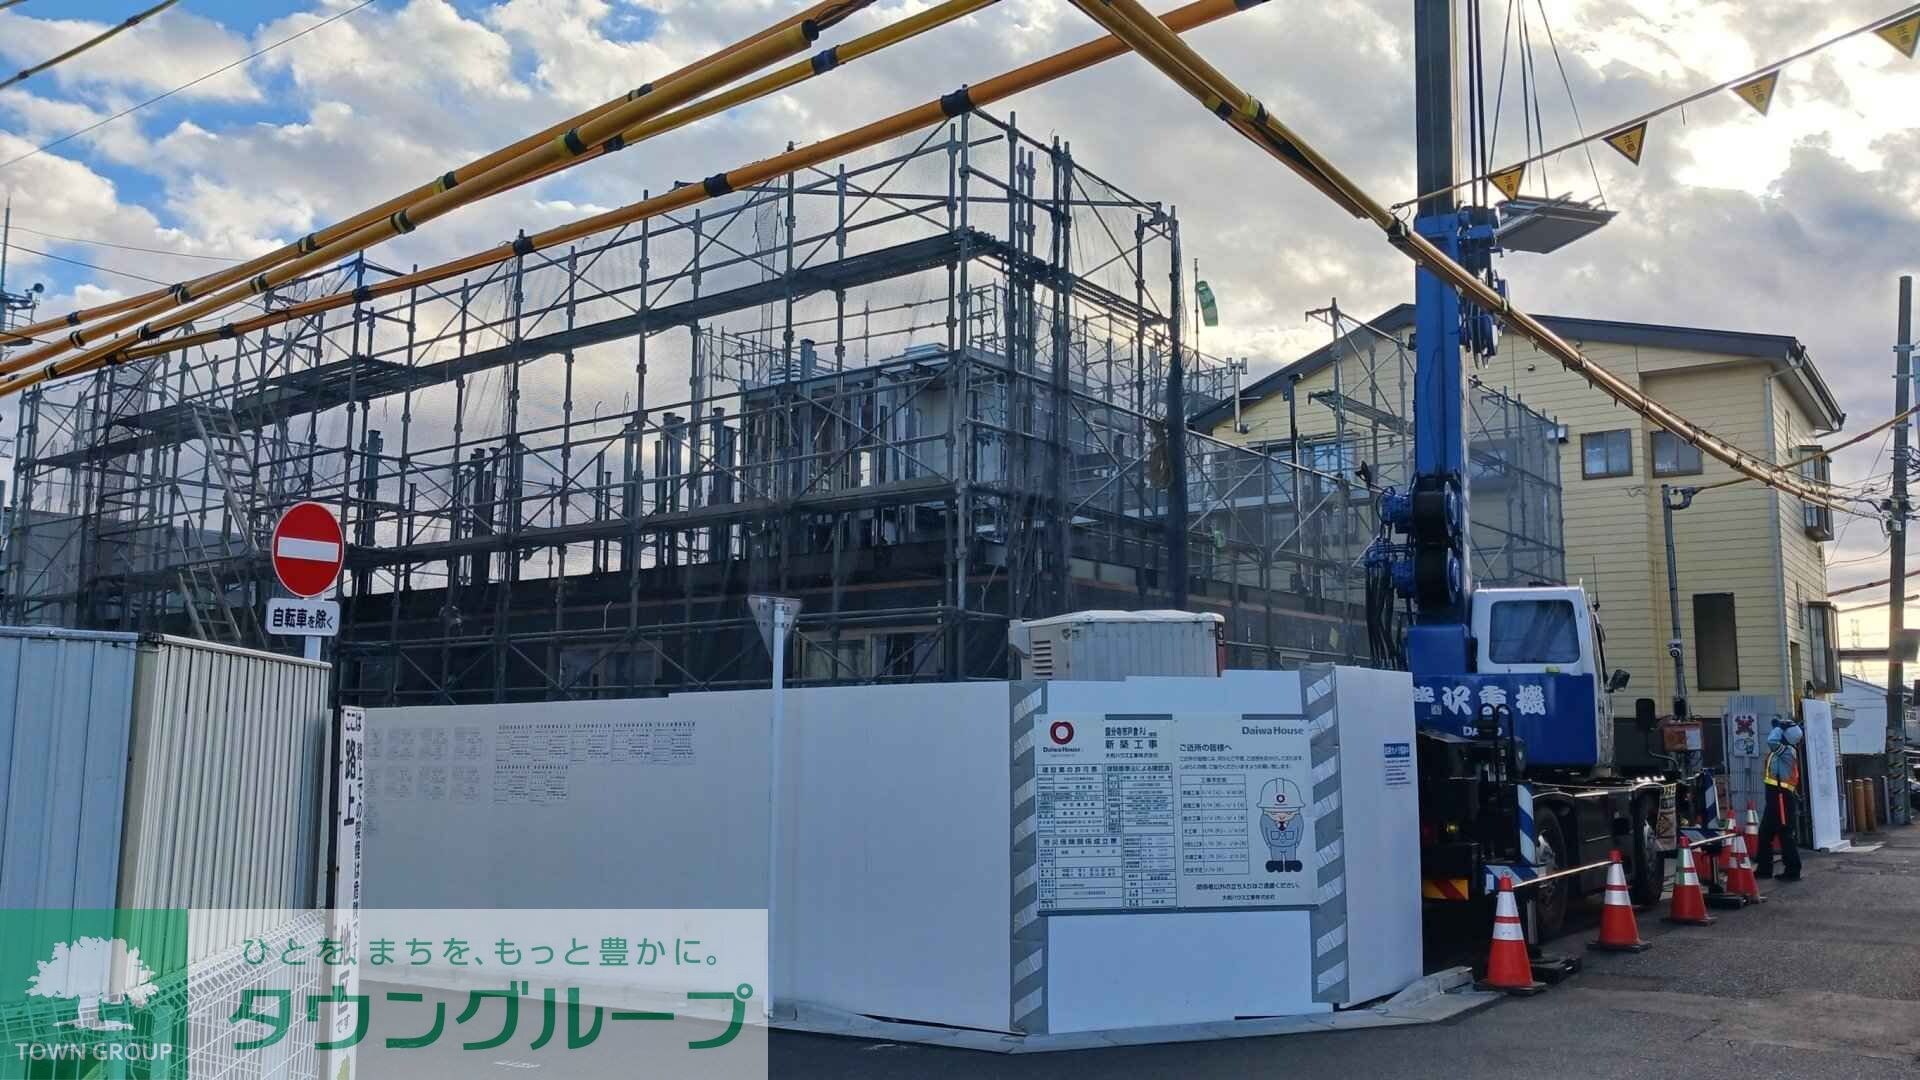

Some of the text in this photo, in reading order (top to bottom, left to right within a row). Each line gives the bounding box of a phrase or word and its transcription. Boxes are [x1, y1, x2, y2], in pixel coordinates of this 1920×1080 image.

[273, 607, 333, 629] 自転車を除く
[1105, 740, 1158, 750] 新築工事
